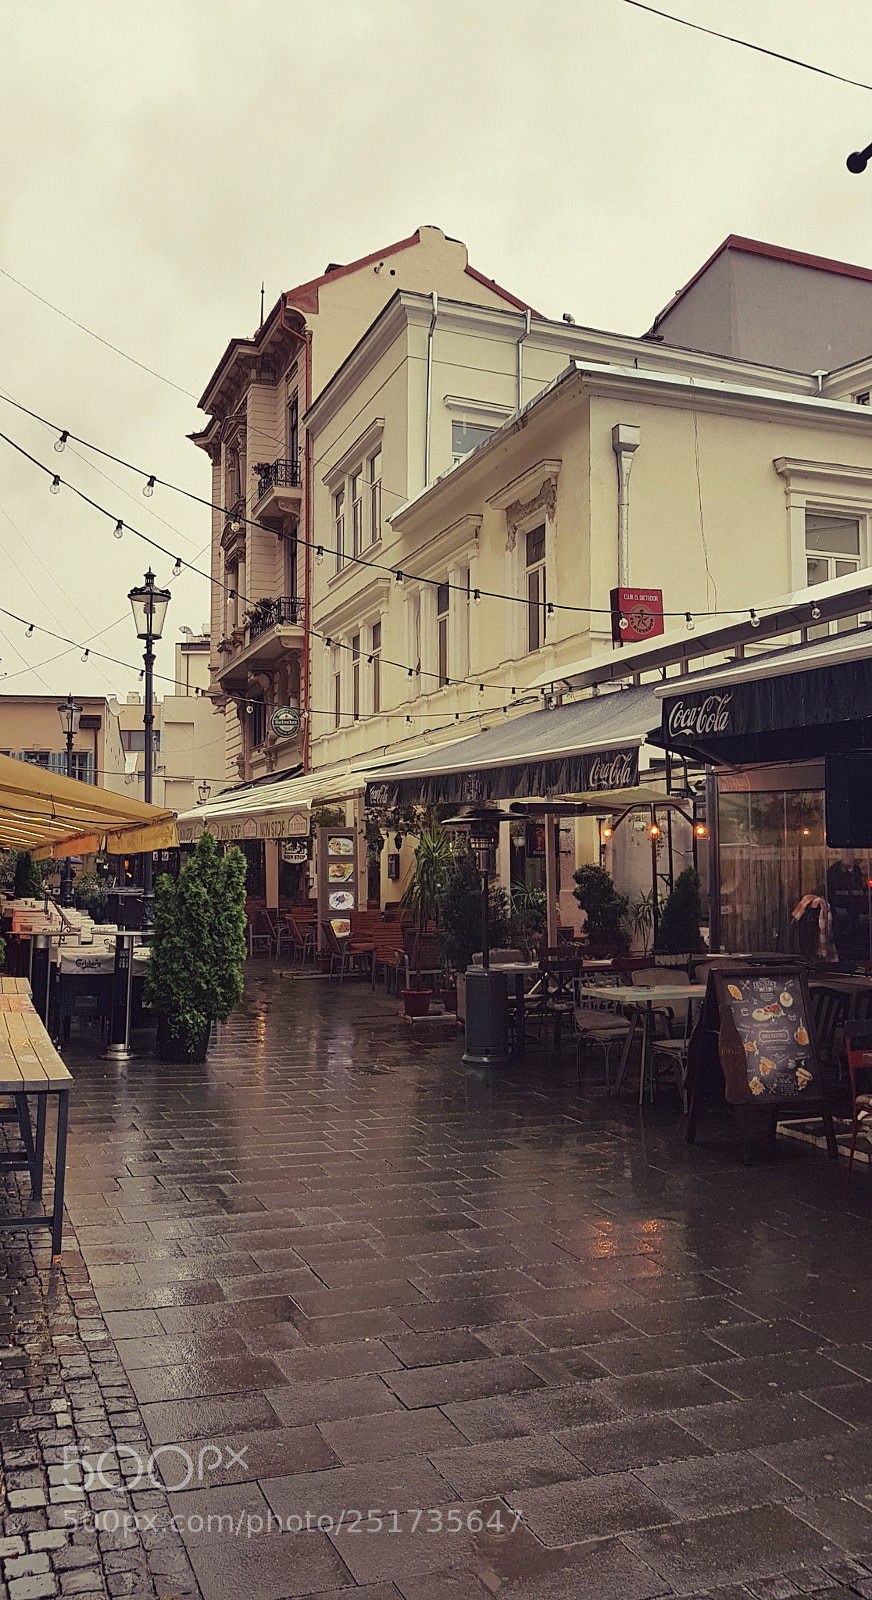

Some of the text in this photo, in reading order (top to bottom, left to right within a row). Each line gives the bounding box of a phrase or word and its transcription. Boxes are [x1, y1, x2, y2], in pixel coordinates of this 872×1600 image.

[623, 593, 634, 601] CLUB
[639, 594, 659, 602] DICTADOR
[668, 692, 733, 738] Coca-Cola
[221, 825, 230, 839] NON
[230, 824, 241, 839] STOP
[259, 821, 270, 838] NON
[270, 820, 285, 837] STOP
[75, 958, 103, 970] Carlsberg
